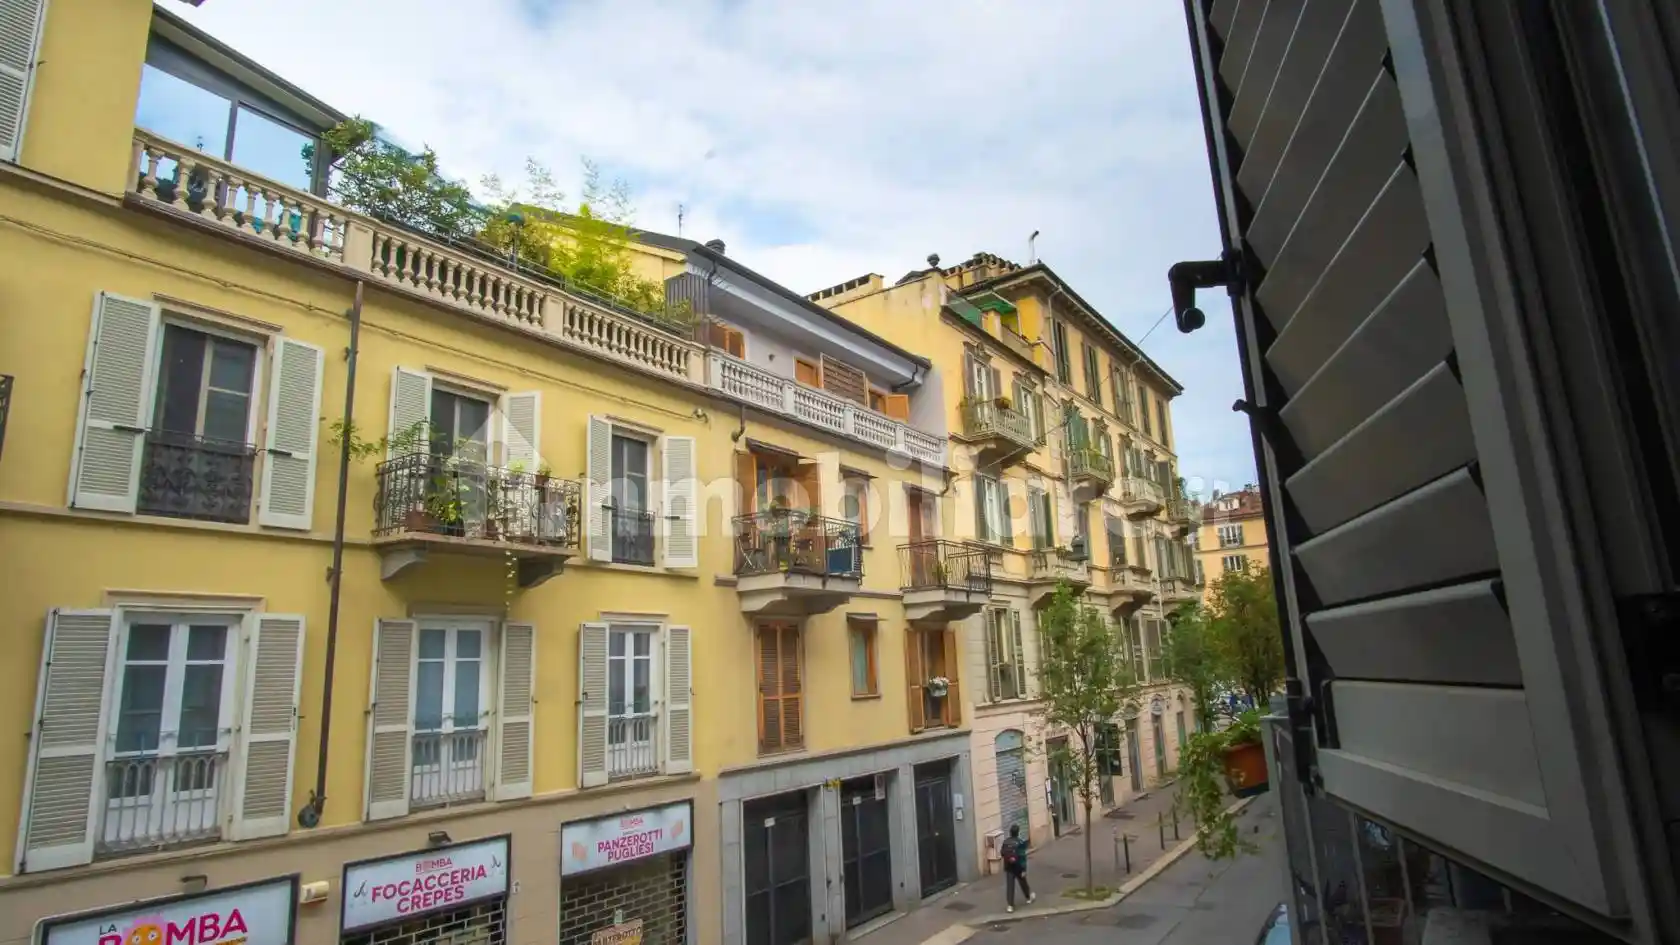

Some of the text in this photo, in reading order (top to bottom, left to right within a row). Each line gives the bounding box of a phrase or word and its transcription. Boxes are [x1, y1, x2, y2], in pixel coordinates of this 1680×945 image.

[597, 828, 662, 853] PANZEROTTI
[607, 842, 654, 862] PUGLIESI
[371, 864, 487, 902] FOCACCERIA
[396, 885, 465, 913] CREPES
[99, 923, 117, 935] LA
